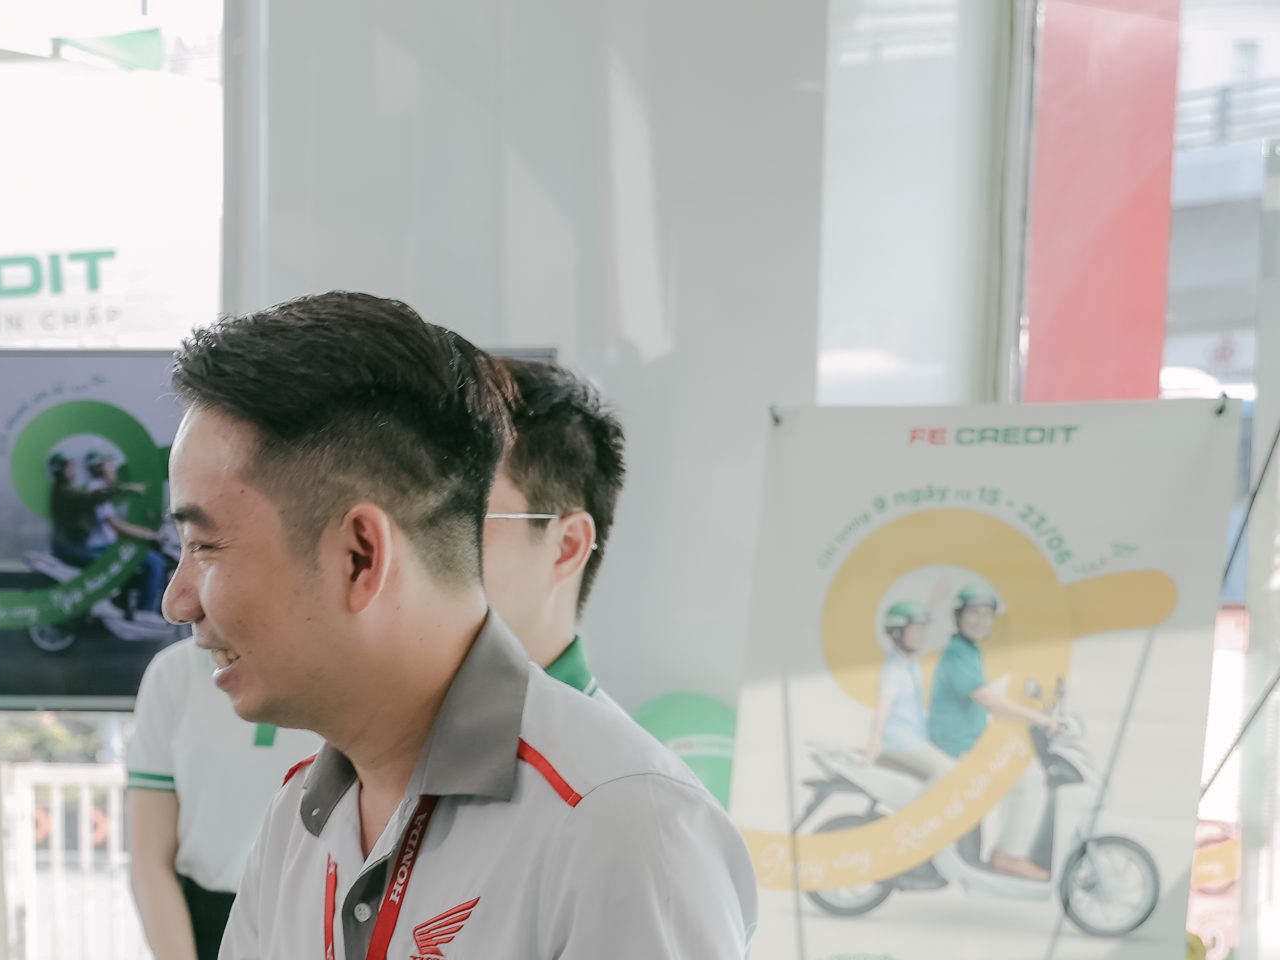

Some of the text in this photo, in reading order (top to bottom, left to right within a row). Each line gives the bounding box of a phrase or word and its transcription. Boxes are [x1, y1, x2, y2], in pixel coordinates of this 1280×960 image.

[909, 425, 1079, 445] FE CREDIT
[389, 812, 427, 905] HONDA
